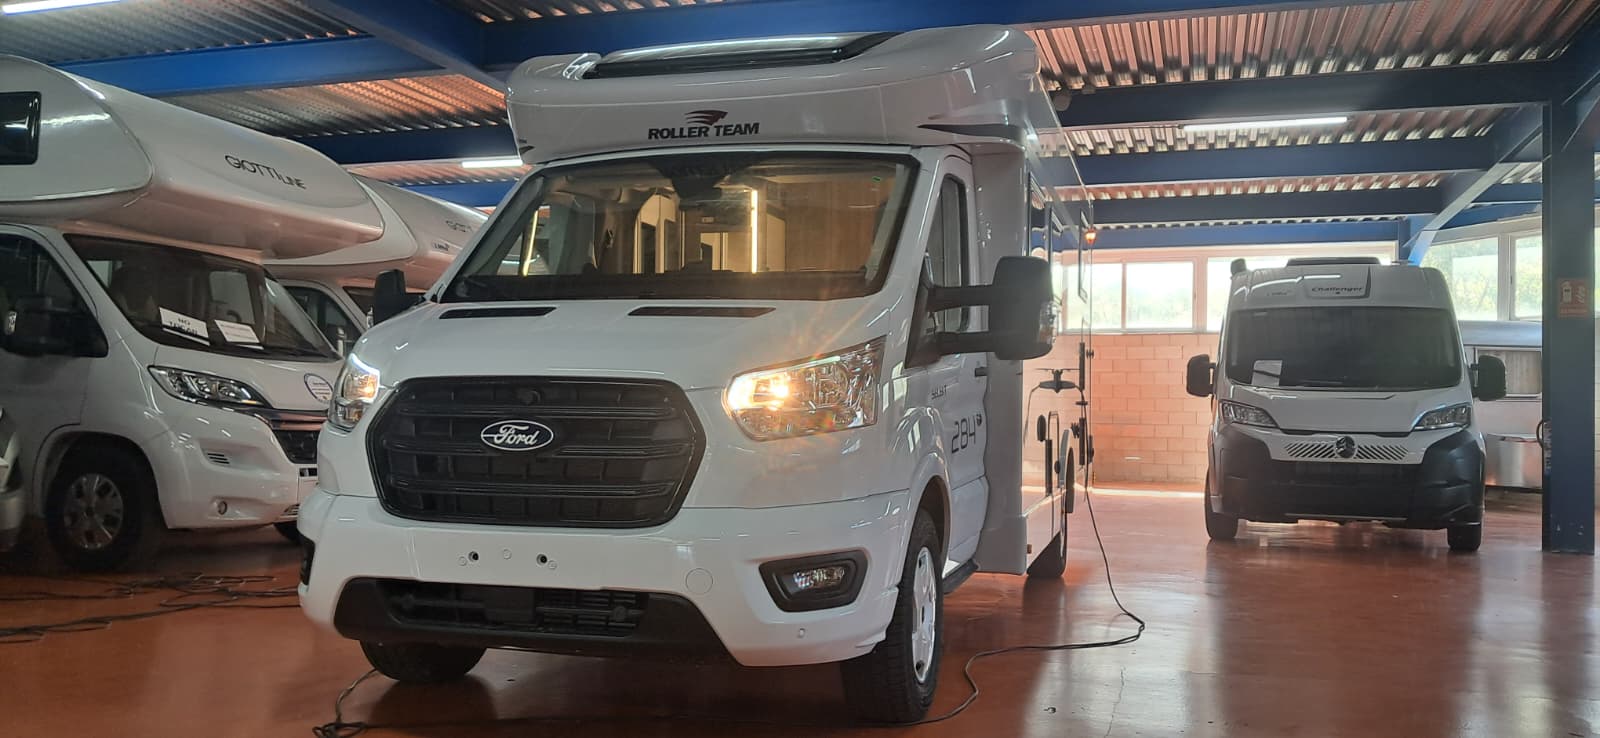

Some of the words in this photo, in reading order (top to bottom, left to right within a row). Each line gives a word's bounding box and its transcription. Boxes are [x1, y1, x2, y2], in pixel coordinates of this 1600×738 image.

[648, 125, 710, 140] ROLLER
[714, 122, 760, 137] TEAM
[493, 424, 540, 445] Ford
[951, 416, 976, 453] 284
